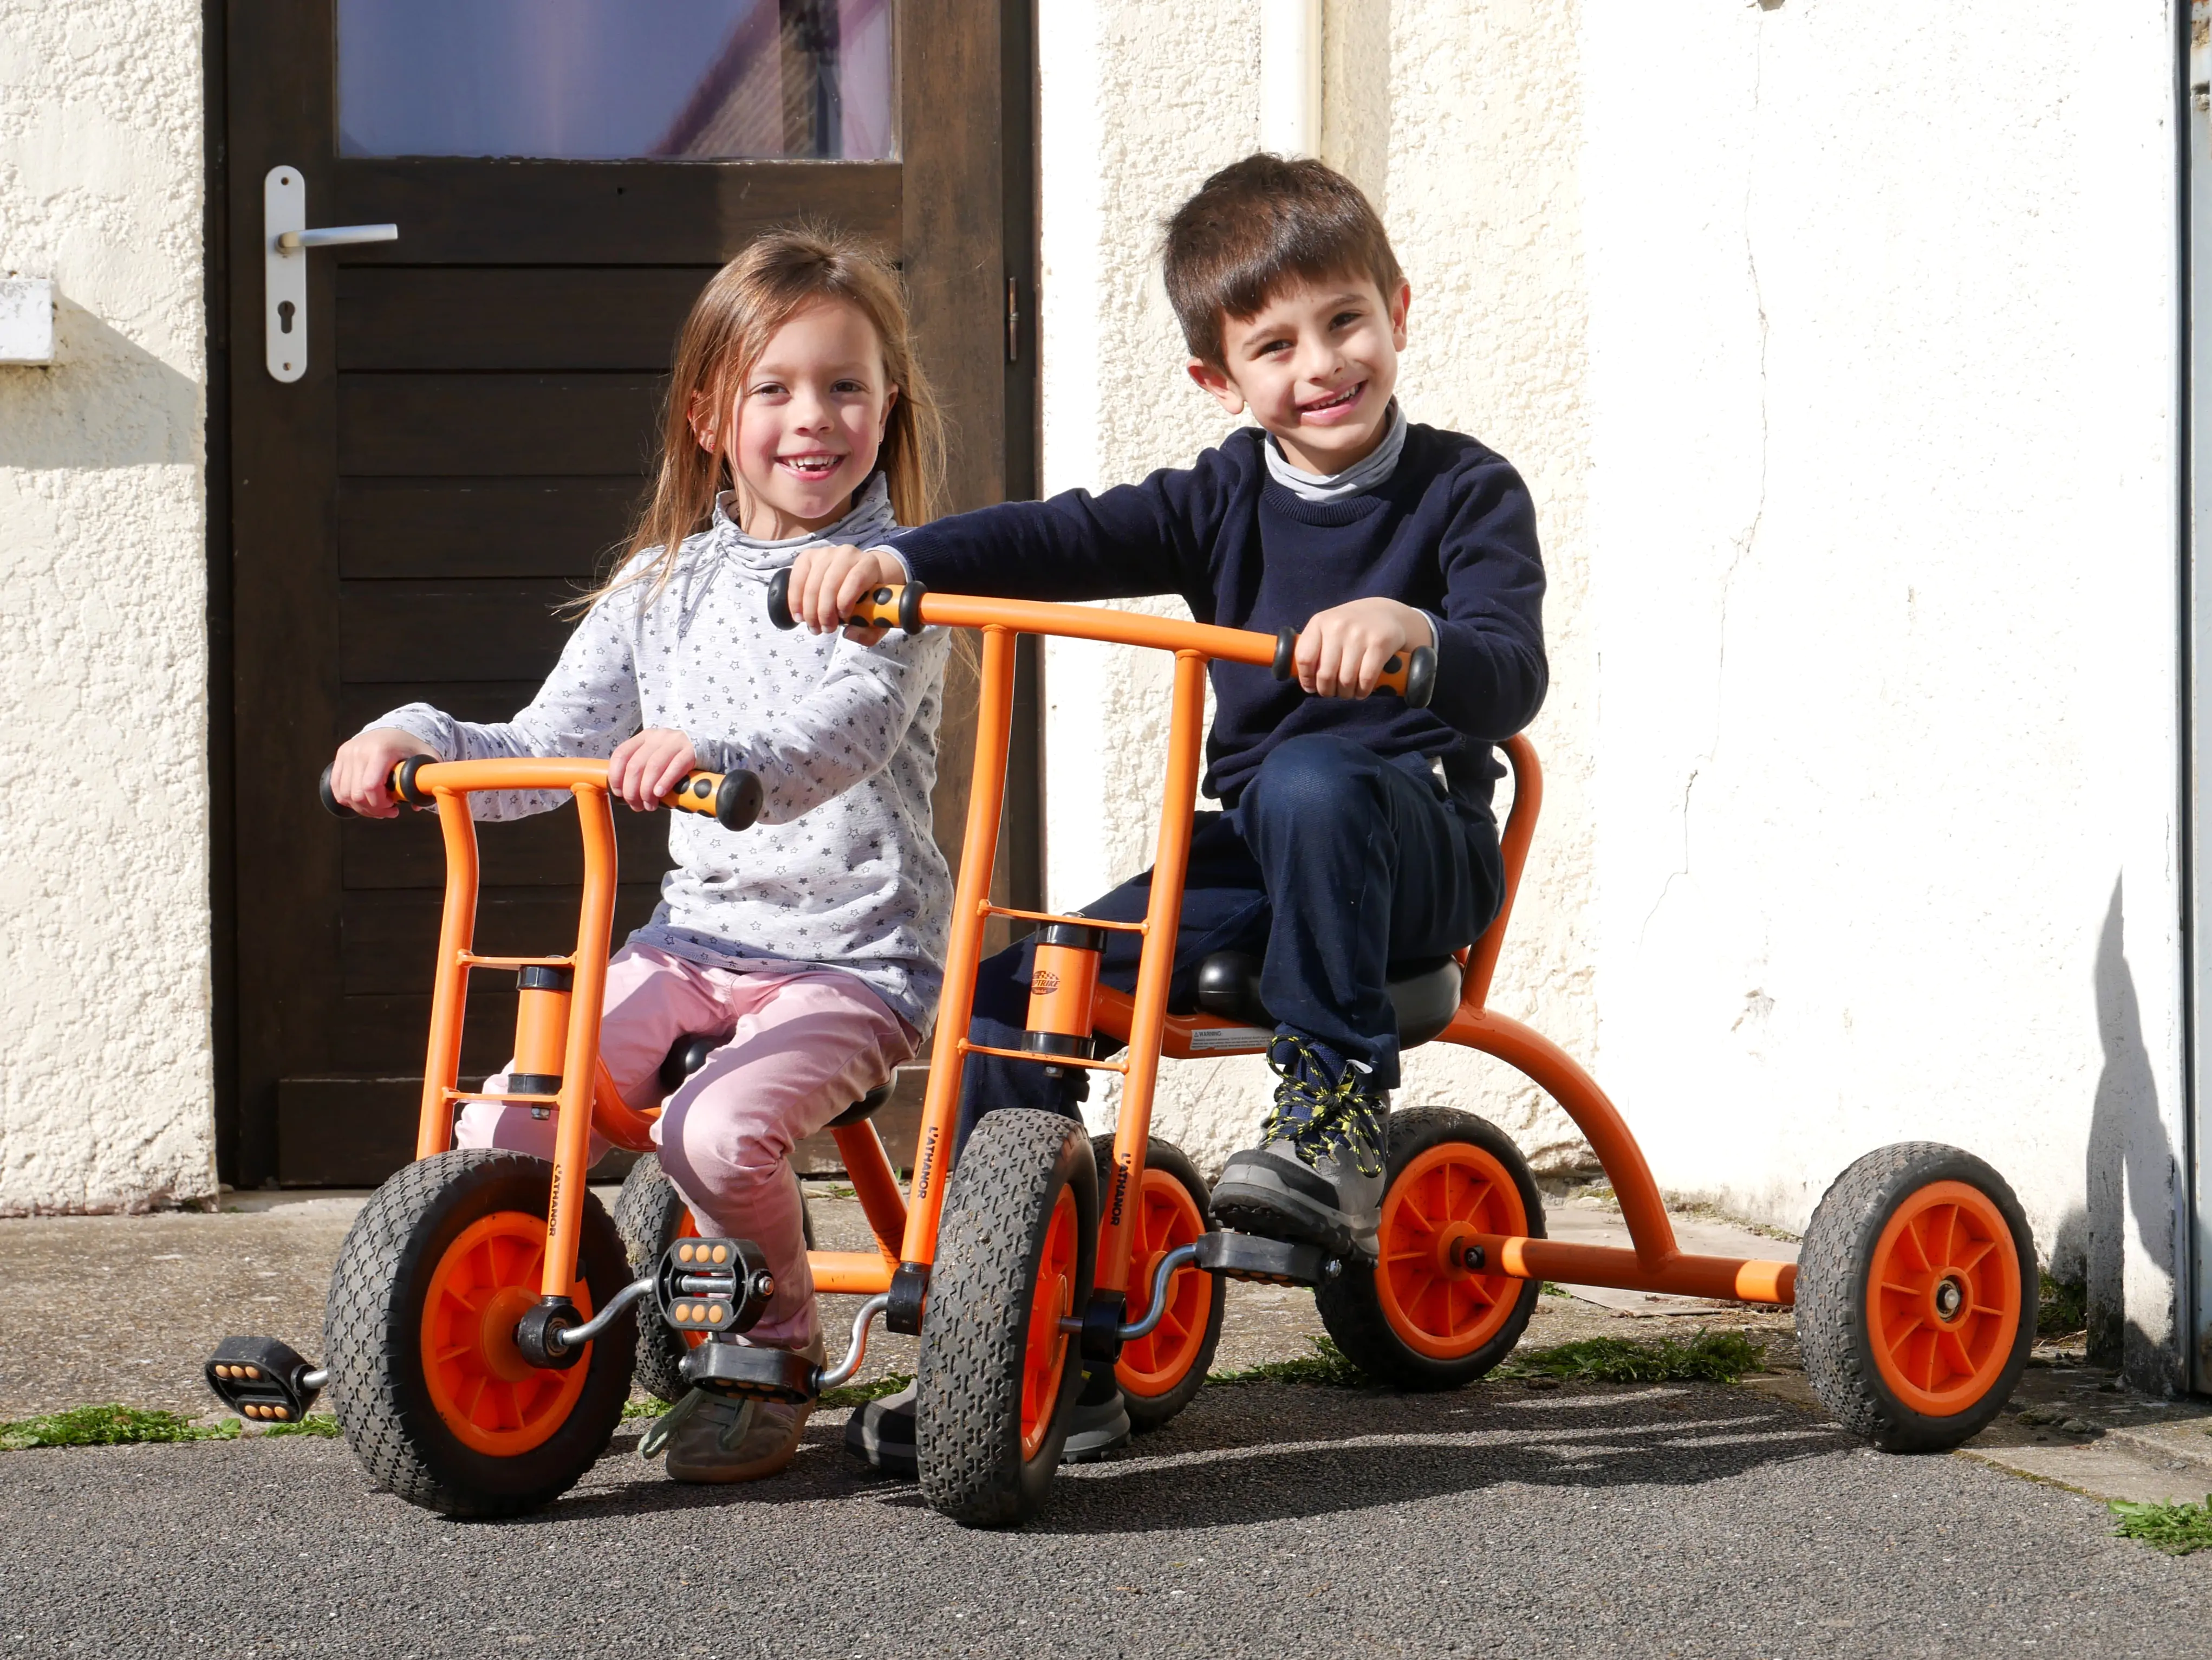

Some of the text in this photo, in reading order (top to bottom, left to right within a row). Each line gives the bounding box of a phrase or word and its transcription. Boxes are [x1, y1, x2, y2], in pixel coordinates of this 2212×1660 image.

[918, 1126, 939, 1199] L'ATHANOR
[1111, 1153, 1131, 1226] L'ATHANOR
[549, 1164, 563, 1237] L'ATHANOR
